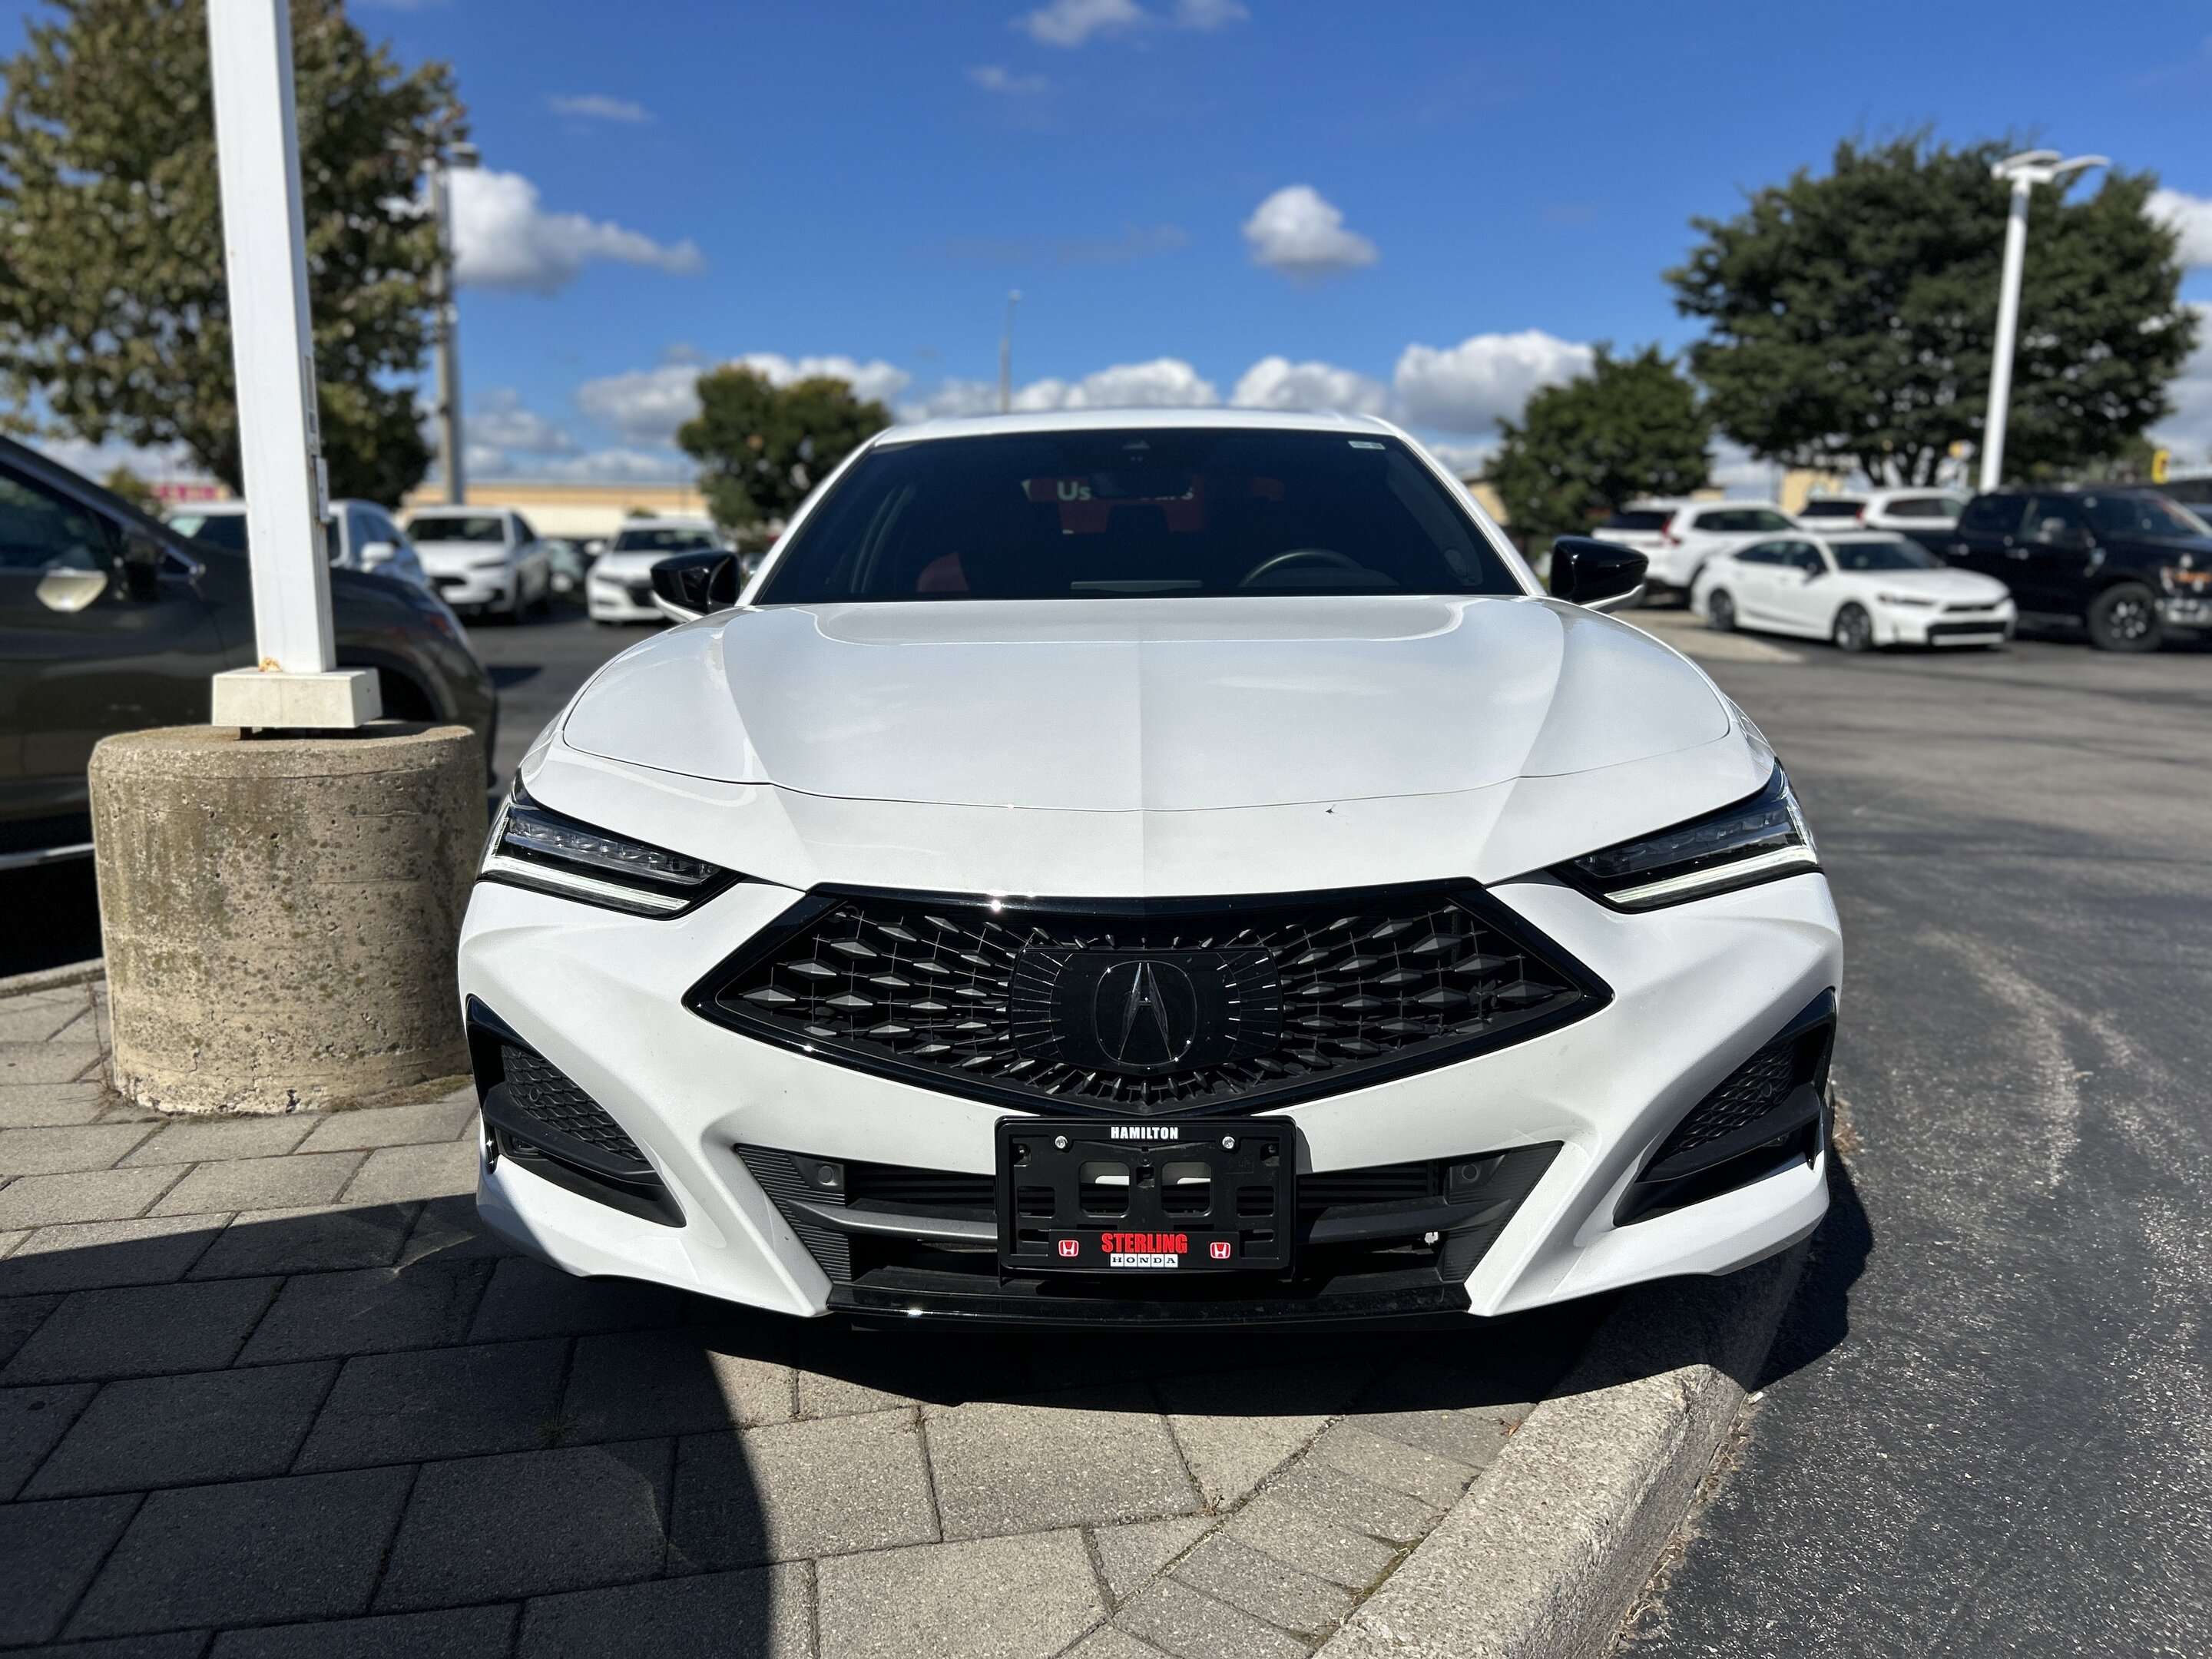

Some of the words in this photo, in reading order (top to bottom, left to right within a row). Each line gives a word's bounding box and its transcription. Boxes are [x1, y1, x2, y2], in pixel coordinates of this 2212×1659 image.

[1057, 481, 1091, 500] Us
[1111, 1126, 1178, 1140] HAMILTON
[1101, 1233, 1187, 1253] STERLING
[1111, 1256, 1176, 1264] HONDA
